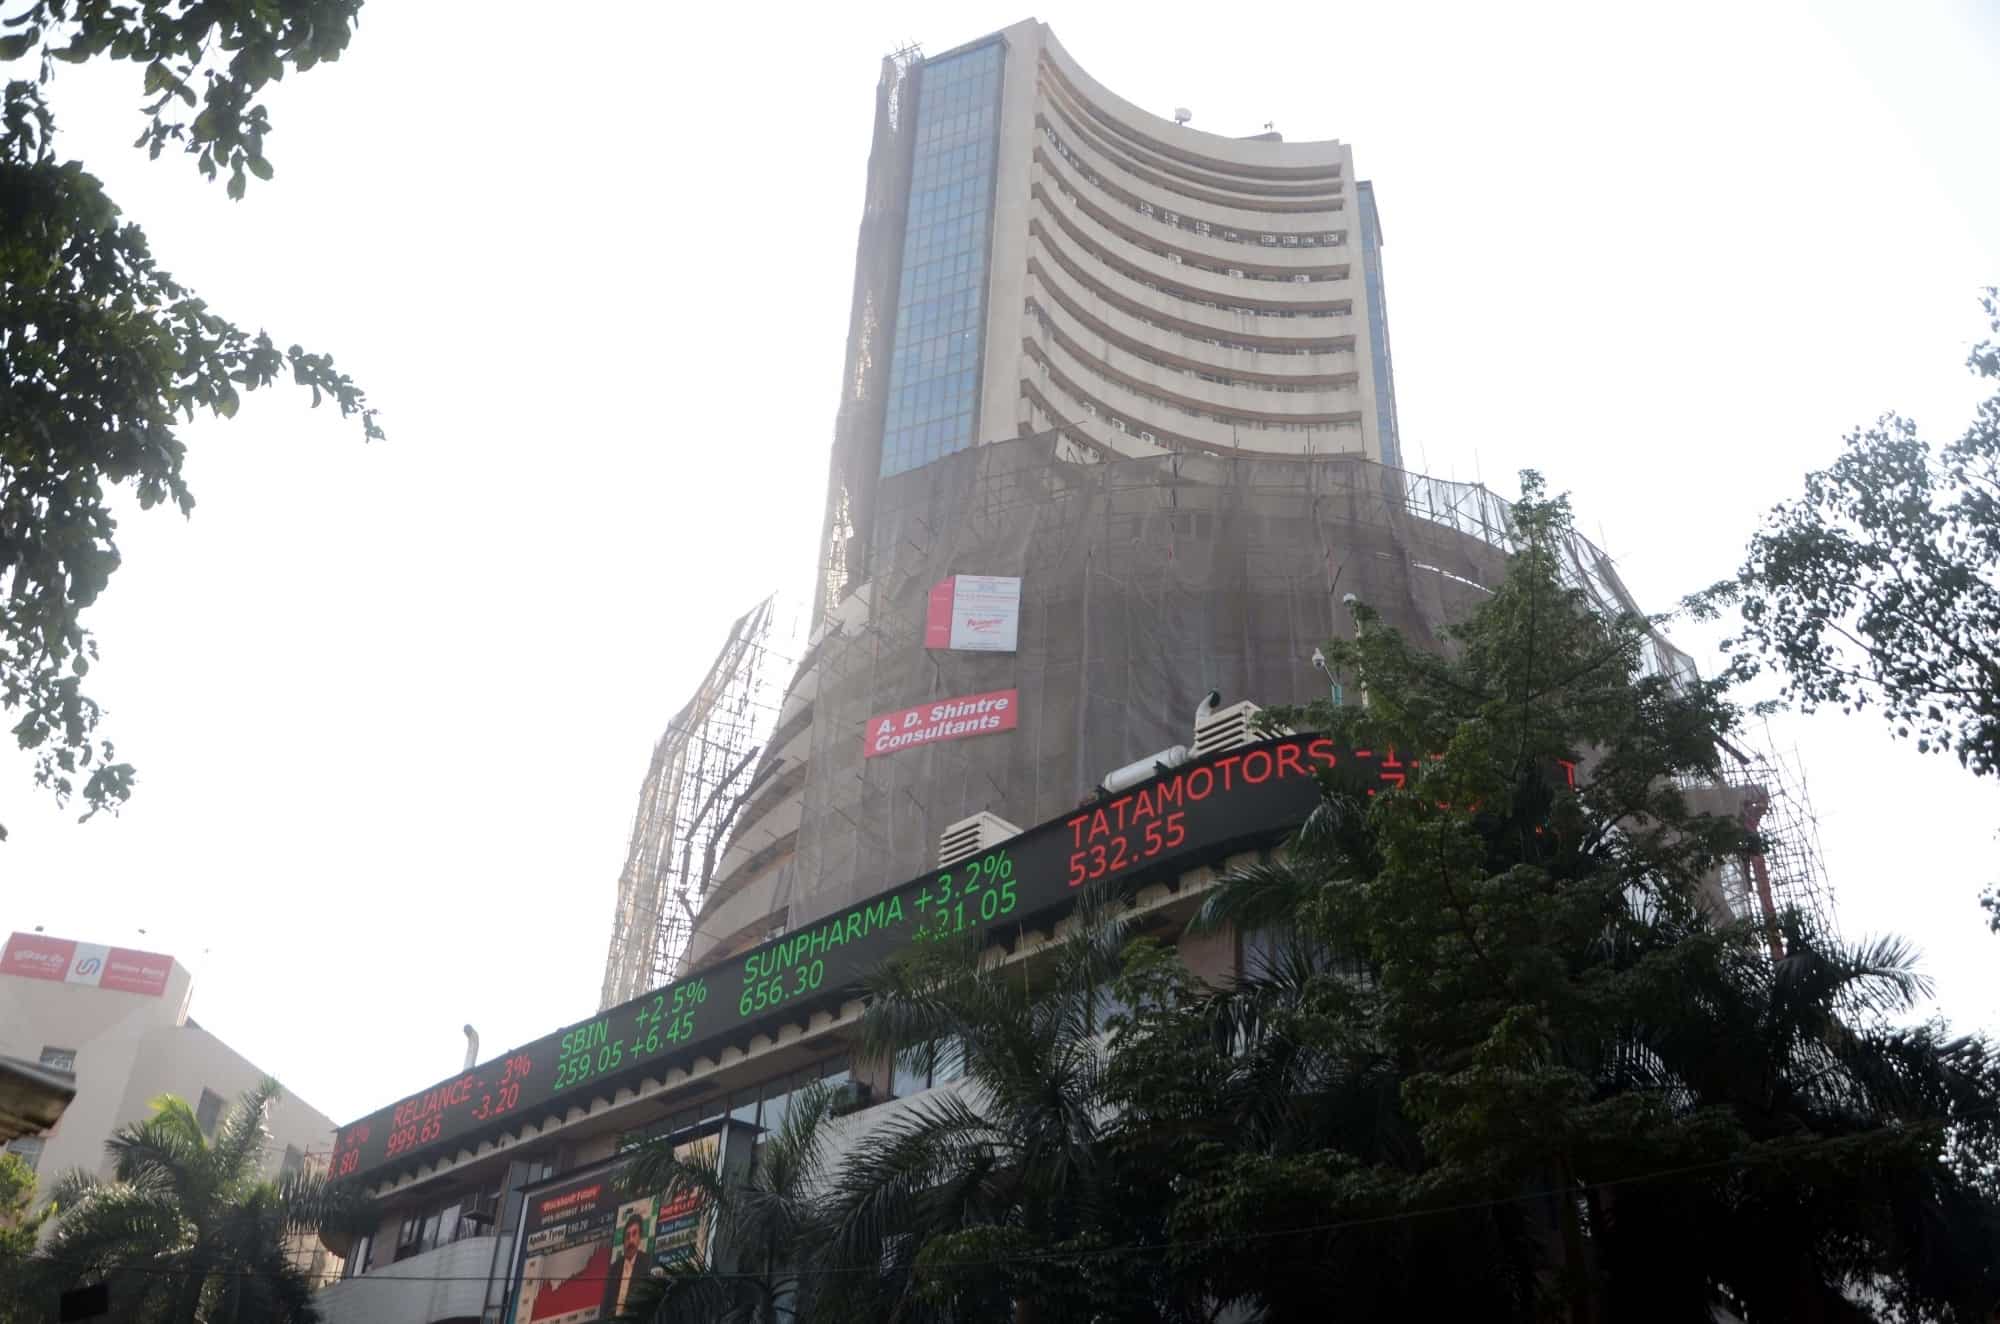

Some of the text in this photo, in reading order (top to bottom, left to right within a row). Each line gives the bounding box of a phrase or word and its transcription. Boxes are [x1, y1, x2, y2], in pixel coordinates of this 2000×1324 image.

[875, 714, 1001, 752] Consultants
[877, 697, 1009, 735] A. D. Shintre
[1067, 738, 1337, 849] TATAMOTORS
[1067, 811, 1186, 888] 532.55
[742, 849, 1014, 985] SUNPHARMA +3.2%
[559, 977, 708, 1061] SBIN +2.5%
[738, 958, 825, 1017] 656.30
[553, 1010, 697, 1092] 259.05 +6.45
[384, 1082, 521, 1158] 999.65 -3.20
[391, 1072, 474, 1131] RELIANCE
